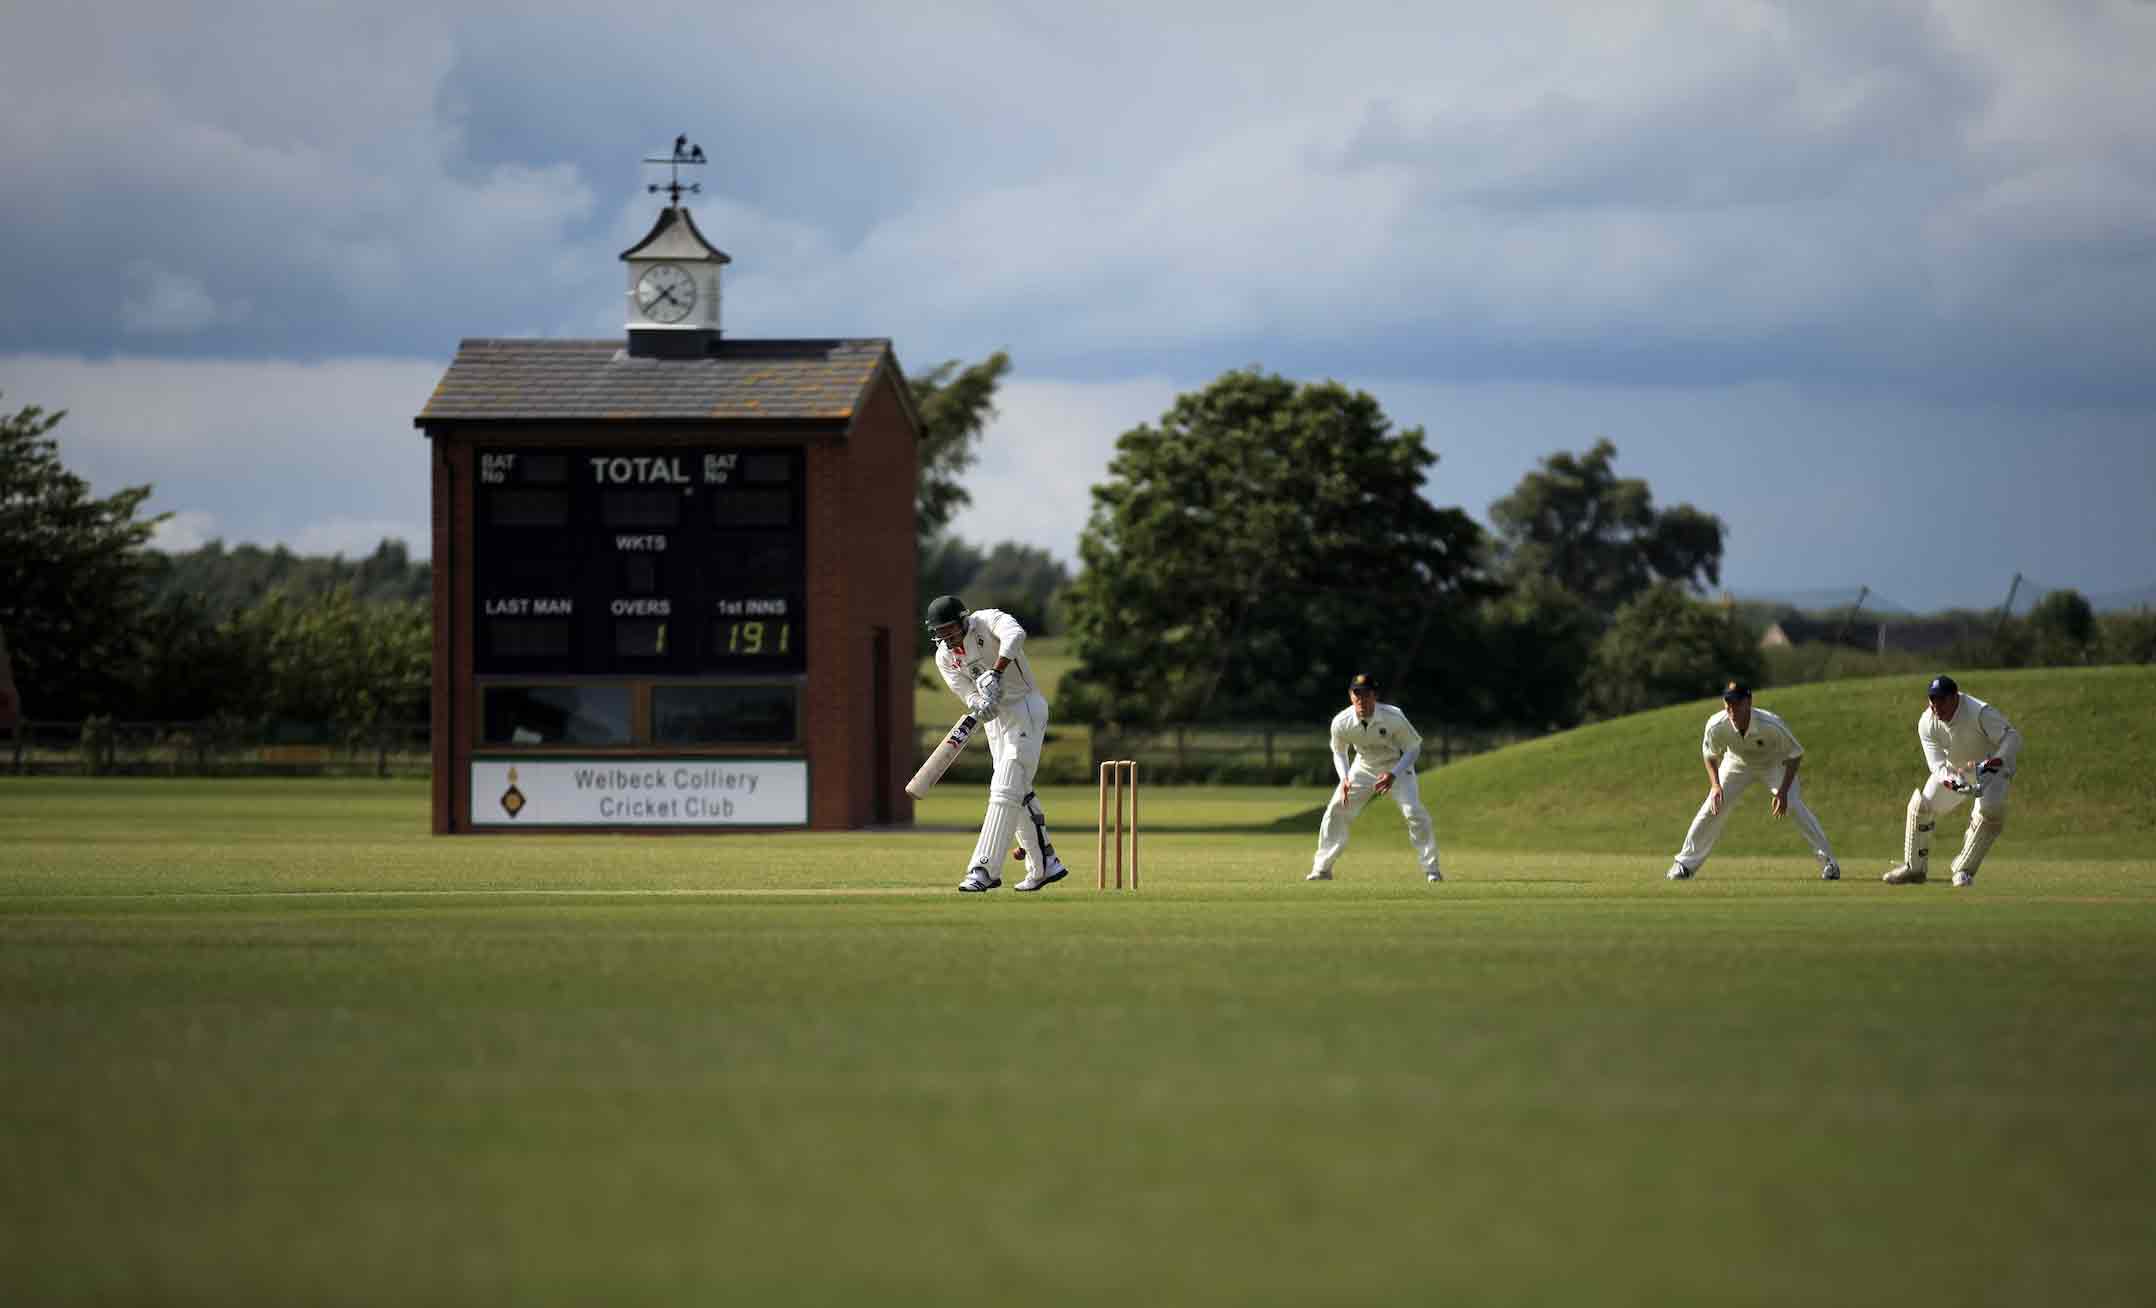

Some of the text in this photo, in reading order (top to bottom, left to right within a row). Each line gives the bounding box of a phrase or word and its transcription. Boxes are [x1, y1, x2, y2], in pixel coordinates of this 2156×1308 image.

[591, 458, 690, 483] TOTAL
[616, 535, 666, 551] WKTS
[485, 600, 572, 616] LAST MAN
[610, 600, 671, 616] OVERS
[718, 600, 787, 615] 1st INNS
[656, 624, 666, 653] 1
[729, 621, 789, 654] 191
[575, 768, 759, 794] Welbeck Colliery
[600, 797, 734, 817] Cricket Club
